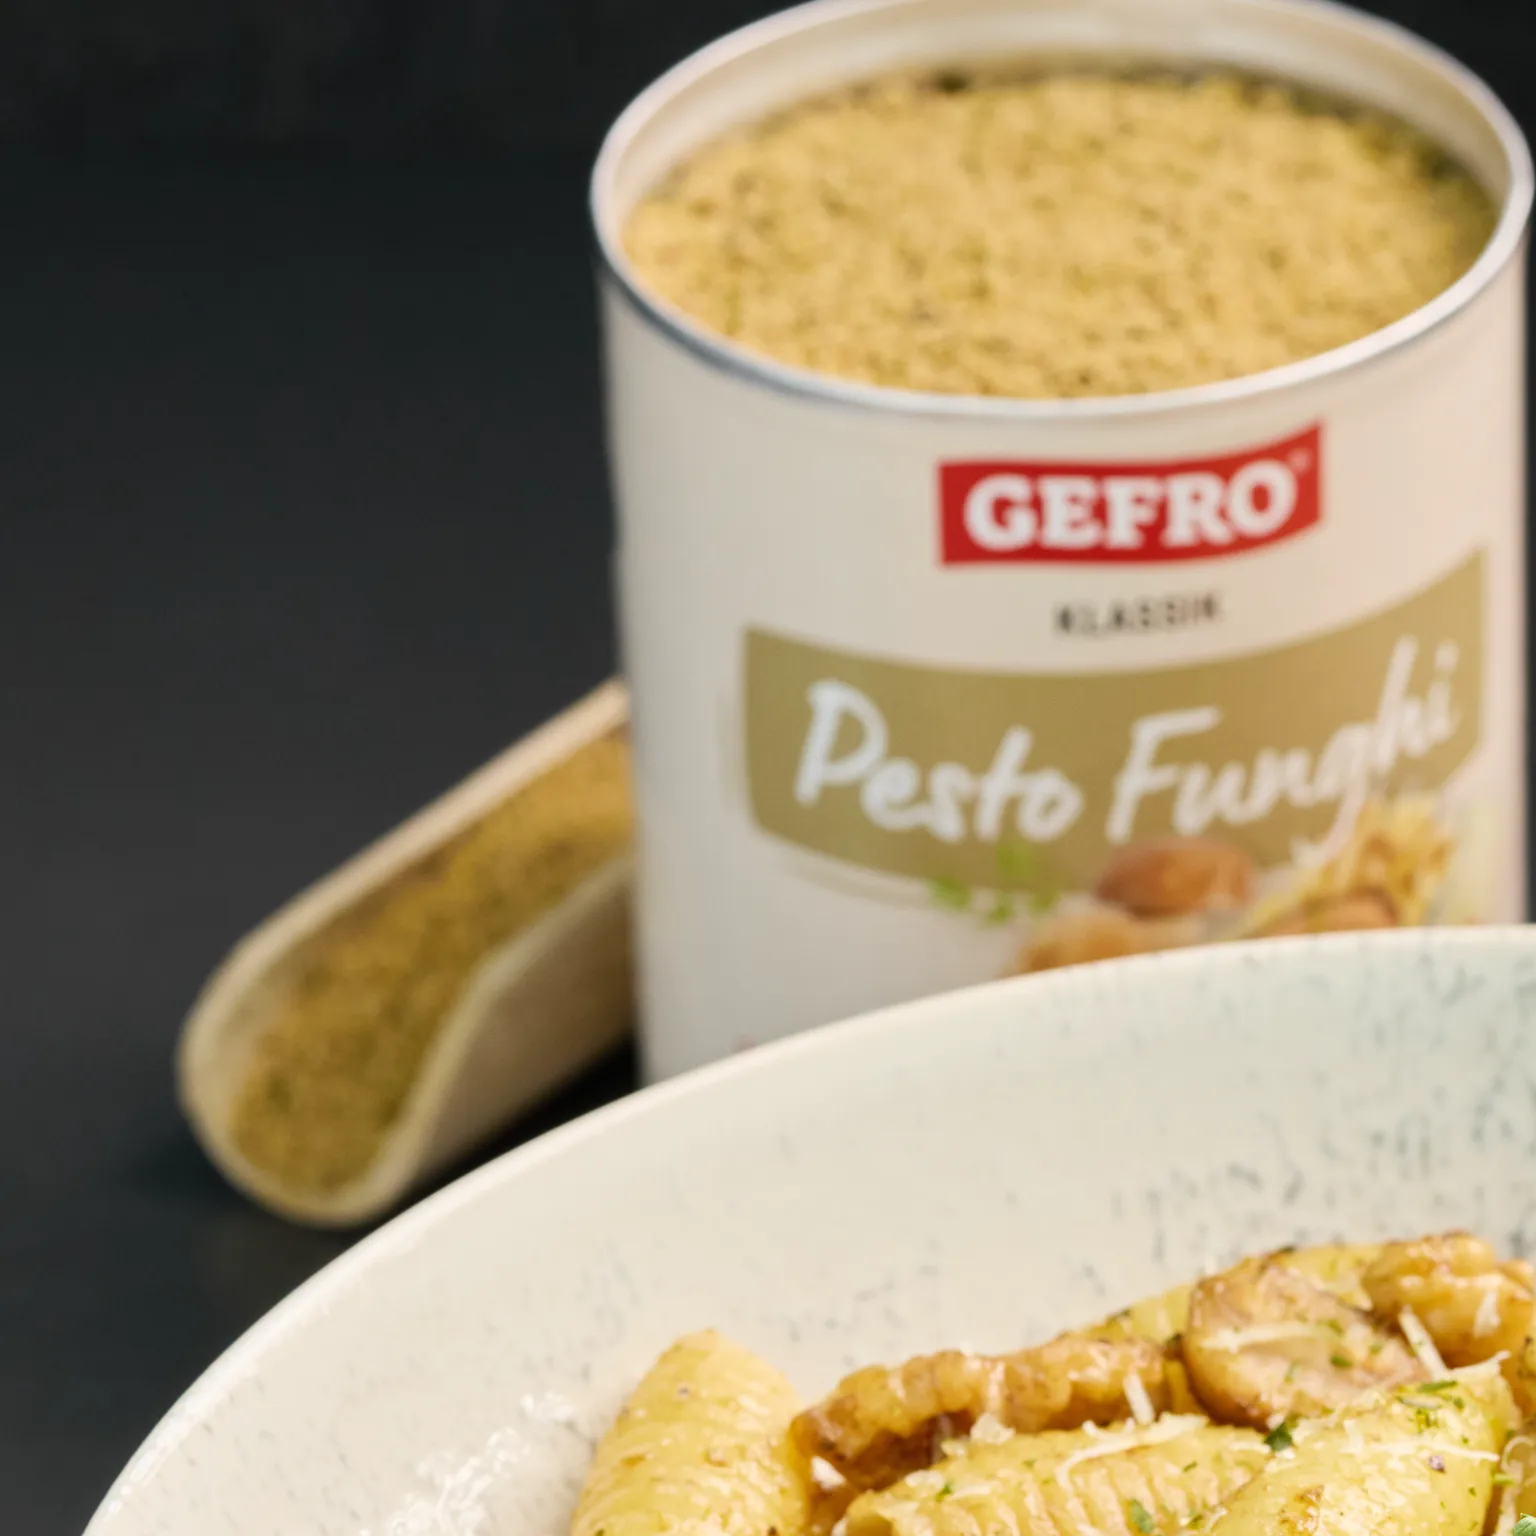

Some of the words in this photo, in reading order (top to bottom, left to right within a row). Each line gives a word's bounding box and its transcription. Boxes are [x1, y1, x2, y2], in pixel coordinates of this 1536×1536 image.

[962, 457, 1298, 552] GEFRO
[1054, 593, 1222, 637] KLASSIK
[794, 677, 1083, 843] Pesto
[1104, 635, 1460, 866] Funghi
